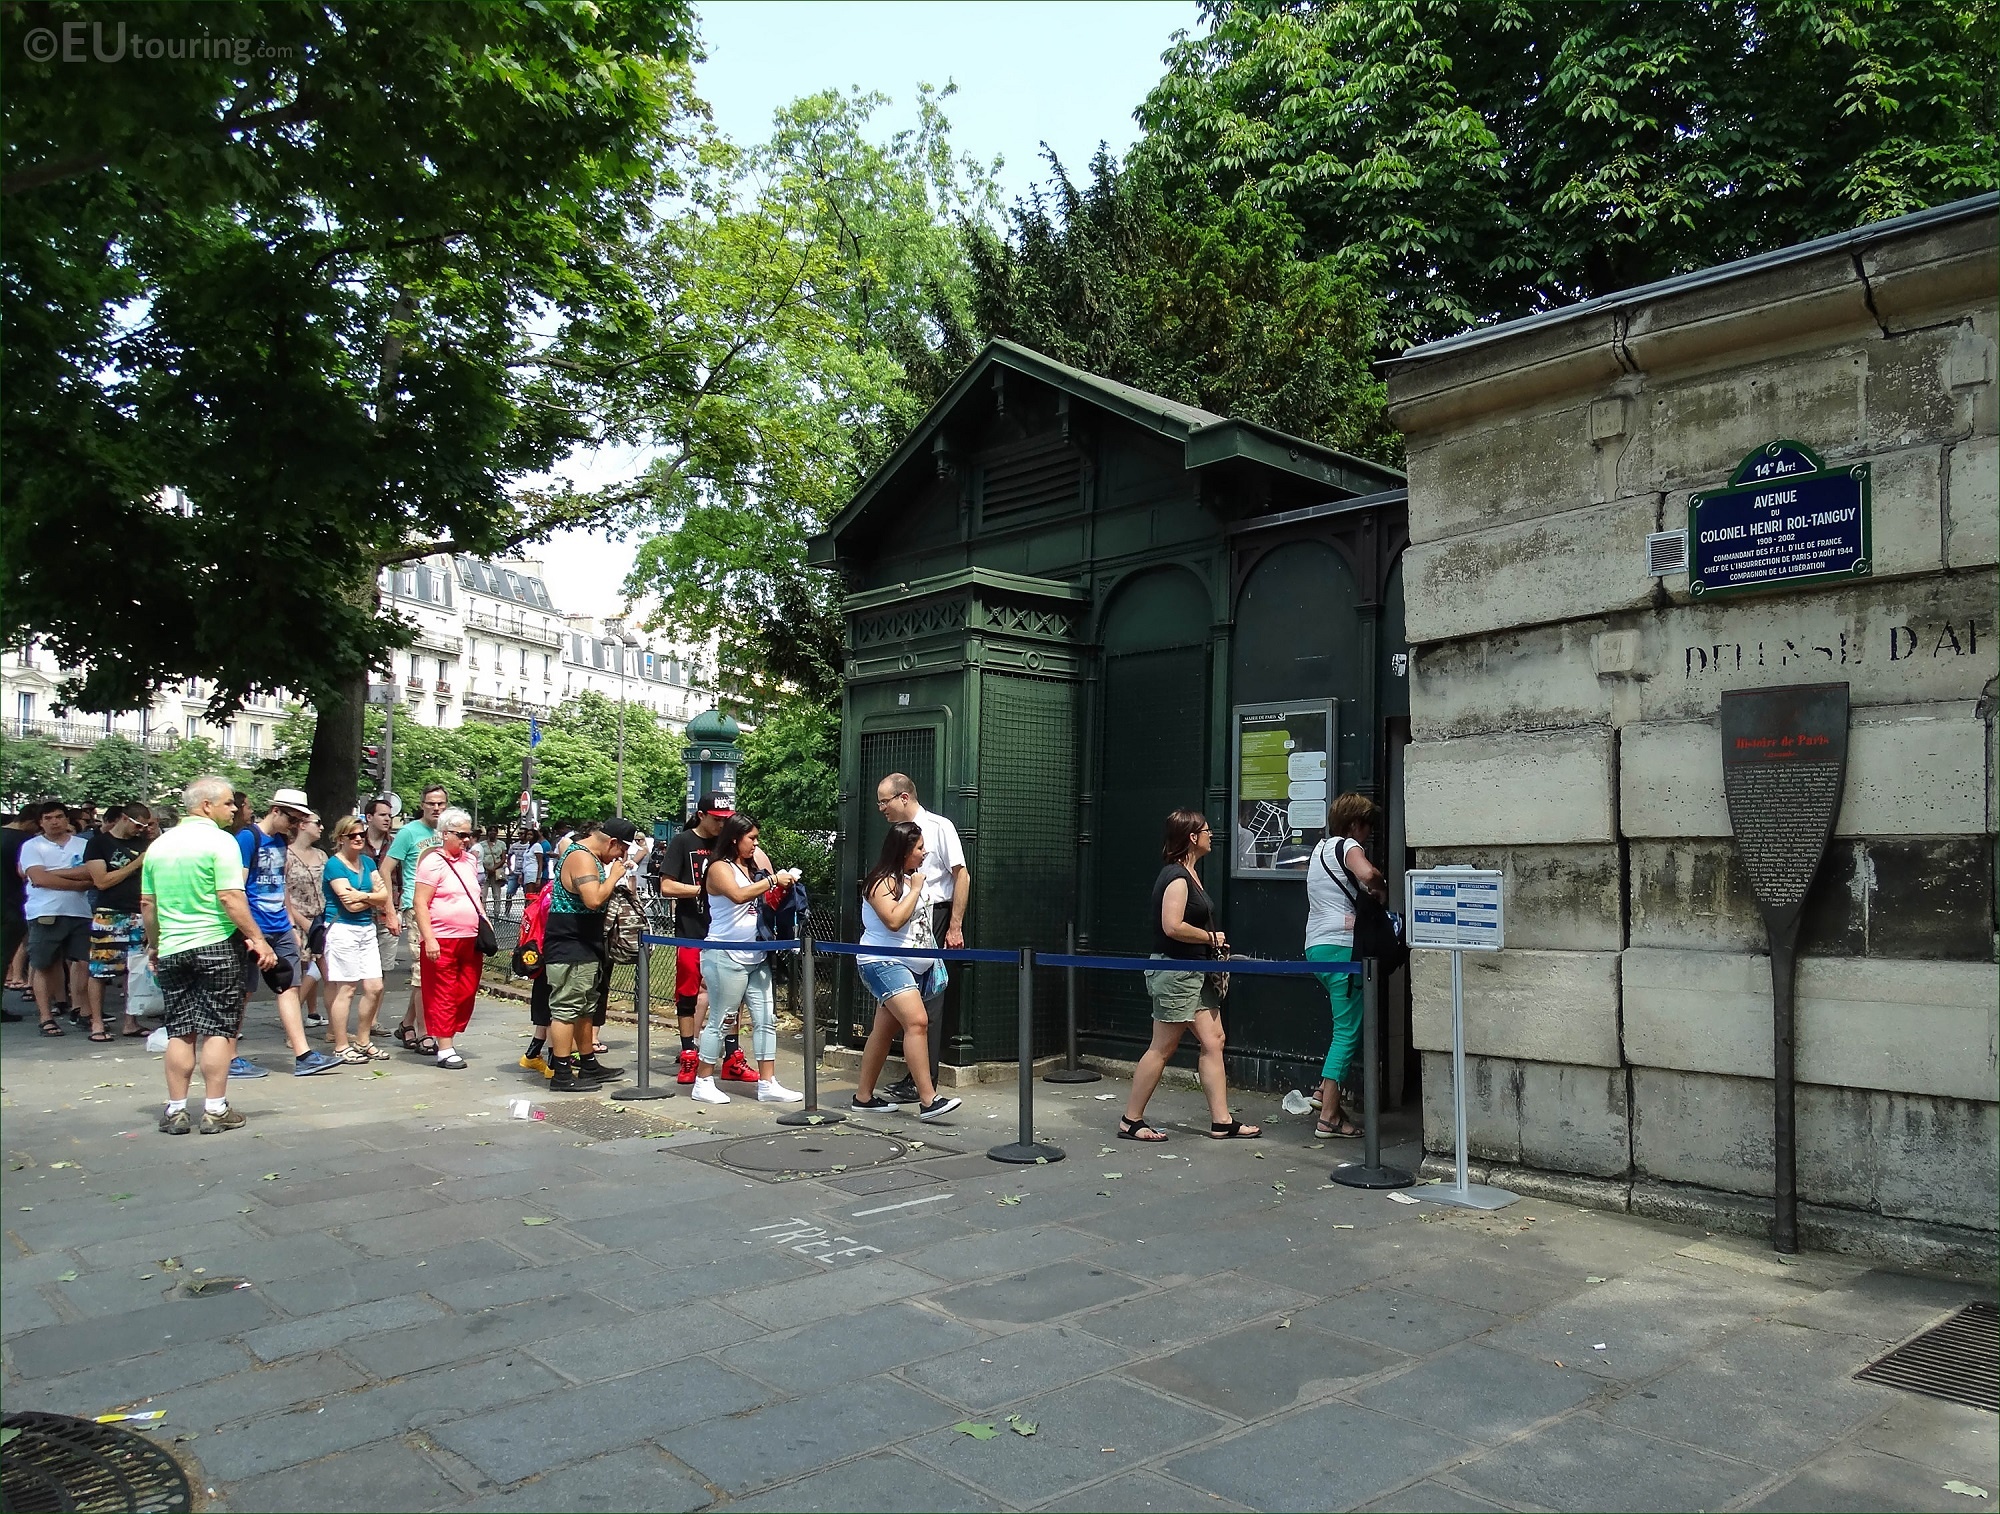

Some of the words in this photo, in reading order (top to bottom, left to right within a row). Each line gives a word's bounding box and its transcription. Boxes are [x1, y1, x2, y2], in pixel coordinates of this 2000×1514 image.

[1754, 490, 1797, 508] AVENUE
[1771, 509, 1780, 517] DU
[1700, 526, 1747, 544] COLONEL
[1750, 519, 1782, 536] HENRI
[1787, 508, 1856, 530] ROL-TANGUY
[1757, 536, 1772, 545] 1908
[1778, 534, 1795, 542] 2002
[1713, 550, 1754, 562] COMMANDANT
[1756, 548, 1768, 556] DES
[1770, 546, 1786, 554] F.F.I.
[1807, 541, 1815, 549] DE
[1817, 537, 1842, 547] FRANCE
[1704, 566, 1719, 574] CHEF
[1730, 556, 1780, 571] L'INSURRECTION
[1792, 552, 1811, 561] PARIS
[1837, 546, 1853, 555] 1944
[1730, 569, 1767, 580] COMPAGNON
[1788, 562, 1825, 572] LIBÉRATION
[1781, 736, 1794, 746] de
[1797, 734, 1829, 745] Paris
